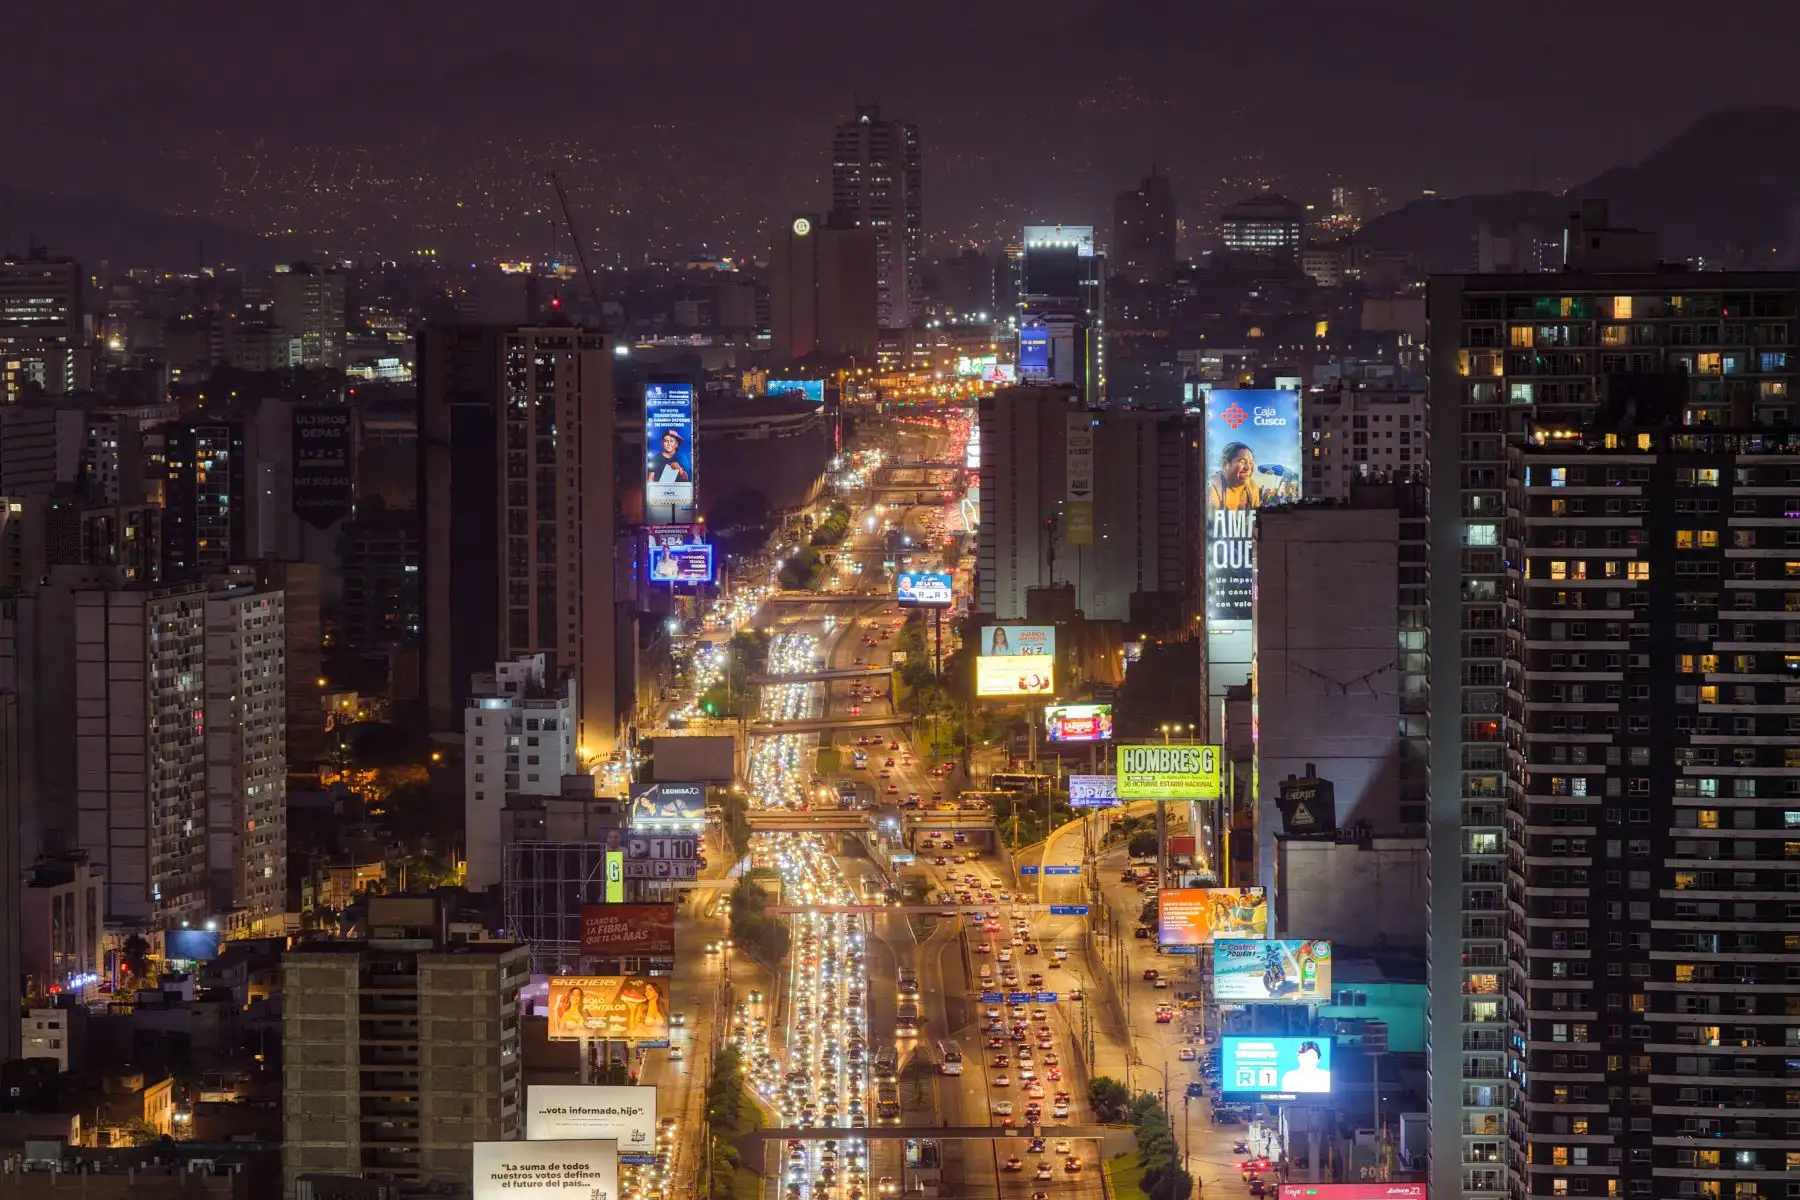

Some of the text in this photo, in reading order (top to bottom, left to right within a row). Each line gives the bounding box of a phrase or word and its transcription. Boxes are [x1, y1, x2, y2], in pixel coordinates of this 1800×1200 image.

[1254, 406, 1276, 418] Caja
[1254, 416, 1286, 426] Cusco
[1124, 748, 1214, 772] HOMBRES G
[656, 840, 664, 858] 1
[672, 840, 693, 858] 10
[609, 860, 619, 882] G
[598, 923, 628, 934] FIBRA
[586, 936, 601, 944] QUE
[1240, 1072, 1251, 1084] R
[569, 1106, 620, 1116] informado,
